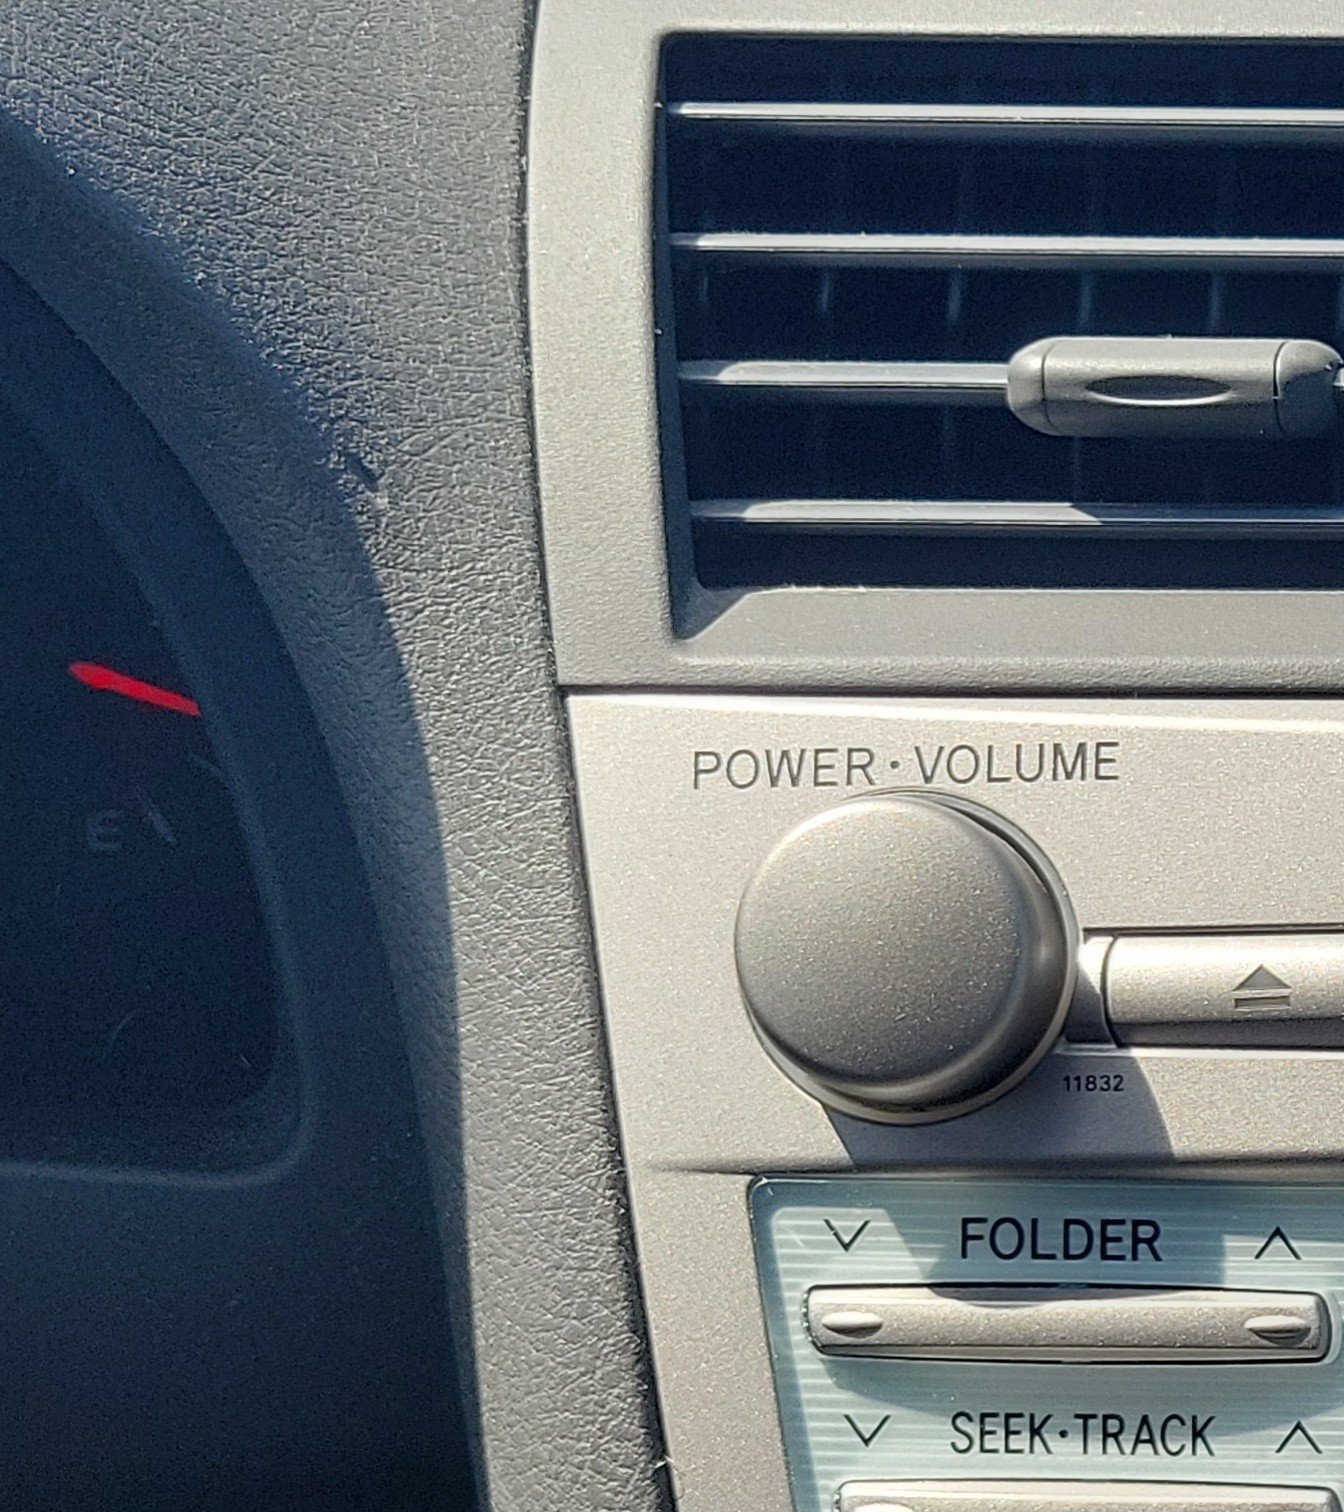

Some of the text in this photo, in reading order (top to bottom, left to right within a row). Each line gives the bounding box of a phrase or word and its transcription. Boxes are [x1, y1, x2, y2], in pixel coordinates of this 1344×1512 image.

[692, 740, 1121, 789] POWER VOLUME
[1062, 1074, 1124, 1092] 11832
[960, 1217, 1163, 1262] FOLDER
